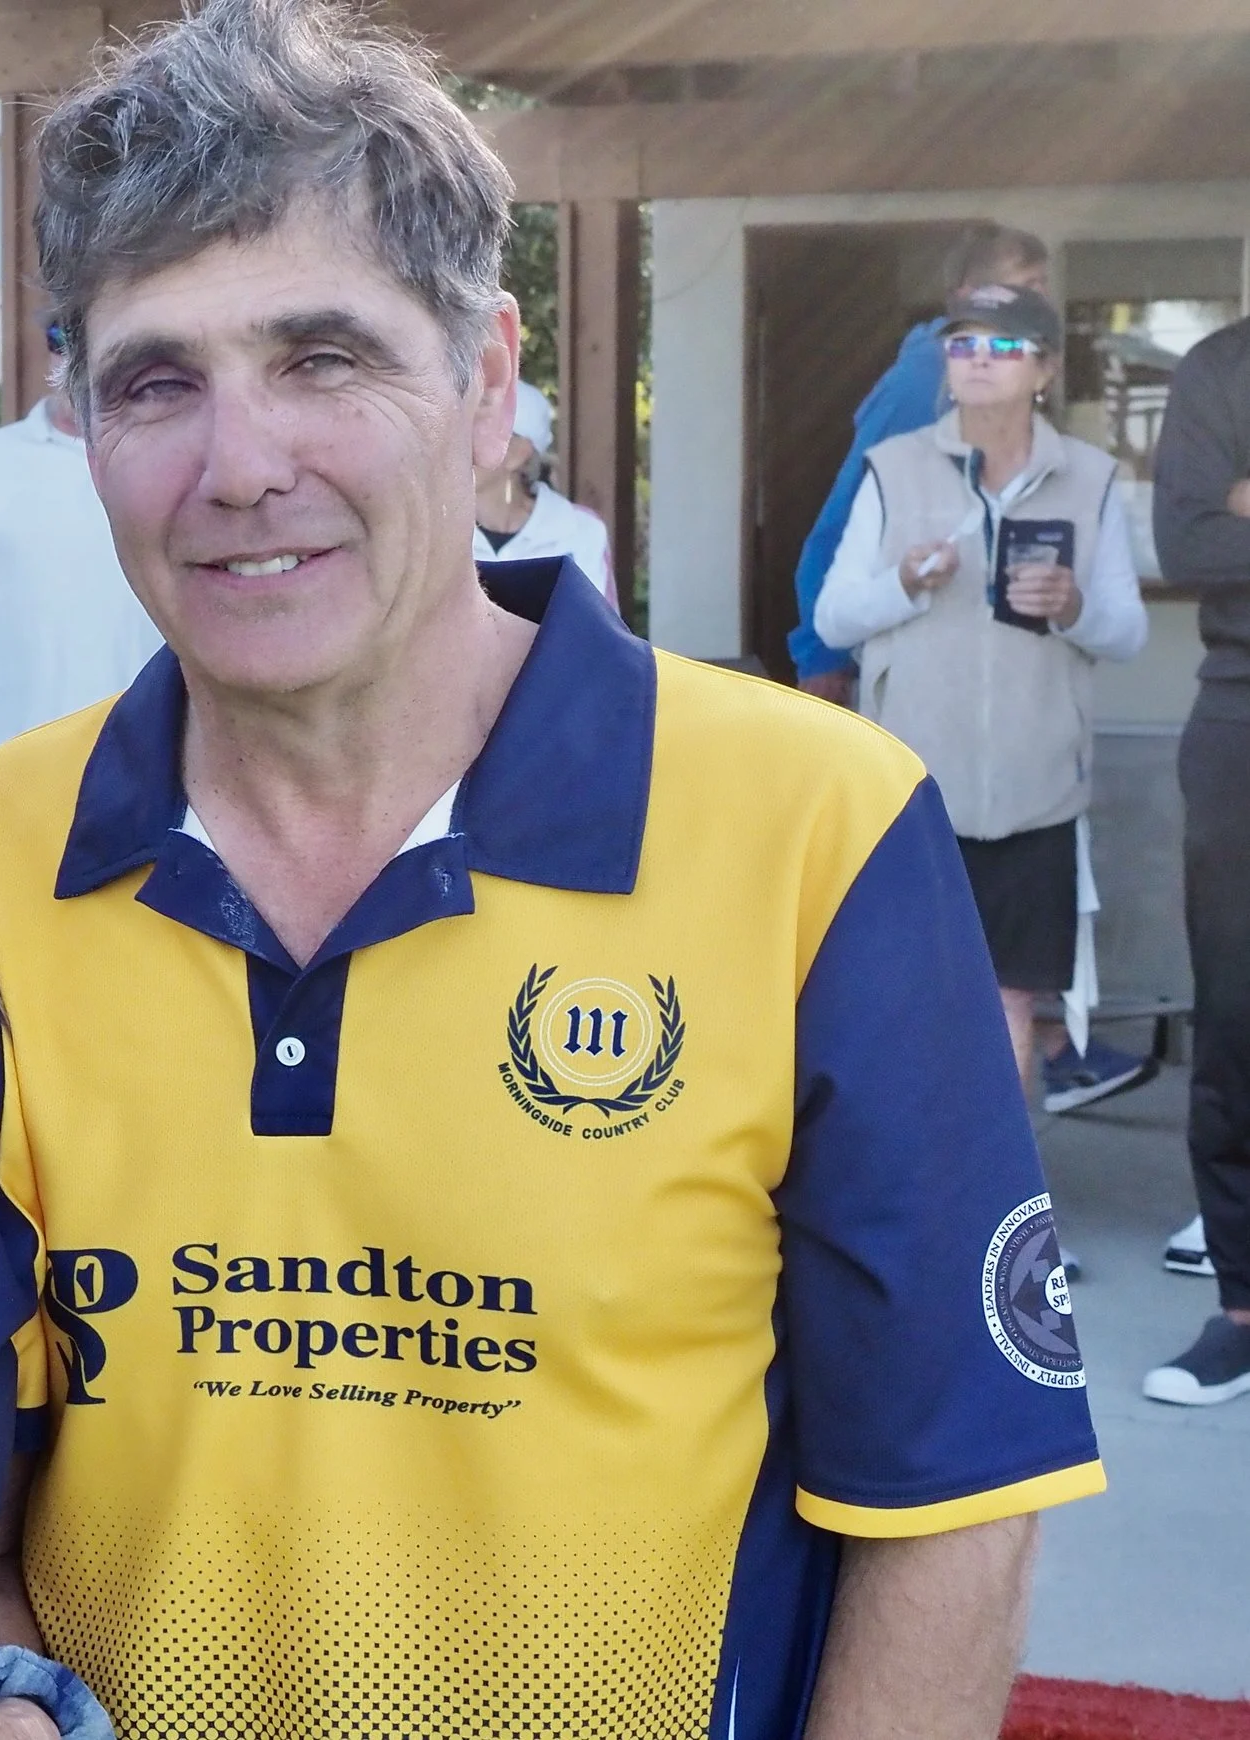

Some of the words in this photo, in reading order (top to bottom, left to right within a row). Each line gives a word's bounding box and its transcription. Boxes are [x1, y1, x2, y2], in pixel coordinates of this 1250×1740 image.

[498, 1061, 573, 1137] MORNINGSIDE
[582, 1112, 650, 1140] COUNTRY
[654, 1078, 686, 1113] CLUB
[989, 1242, 1001, 1258] IN
[172, 1242, 538, 1316] Sandton
[984, 1259, 996, 1319] LEADERS
[172, 1305, 538, 1374] Properties
[995, 1328, 1030, 1373] INSTALL
[249, 1380, 304, 1398] Love
[308, 1383, 399, 1407] Selling
[1037, 1370, 1080, 1386] SUPPLY
